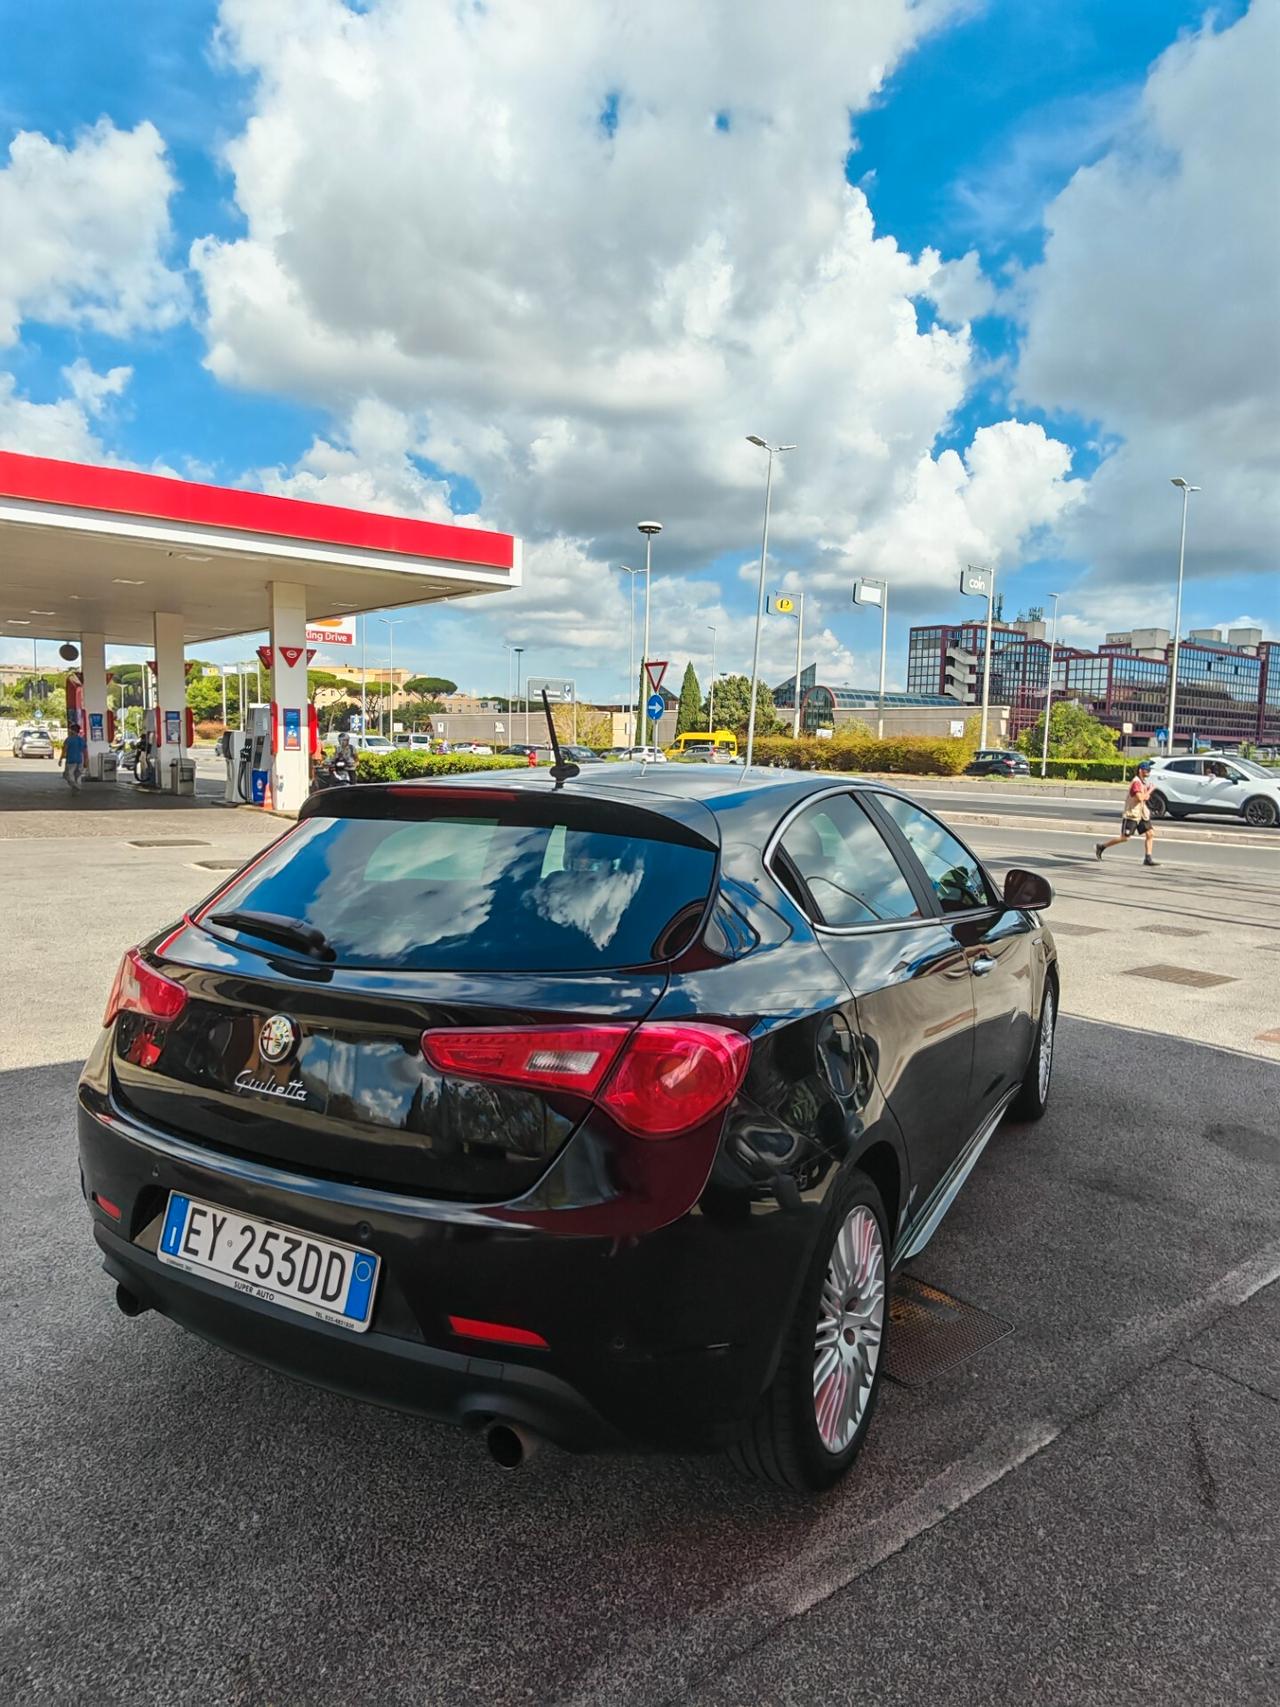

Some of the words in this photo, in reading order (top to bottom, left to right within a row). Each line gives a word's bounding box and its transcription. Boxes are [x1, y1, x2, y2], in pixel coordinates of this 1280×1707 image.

[969, 576, 985, 591] coin
[325, 631, 348, 642] Drive
[234, 1069, 308, 1102] Giulietta
[183, 1207, 227, 1261] EY
[232, 1225, 346, 1302] 253DD
[234, 1281, 254, 1294] SUPER
[256, 1289, 275, 1301] AUTO
